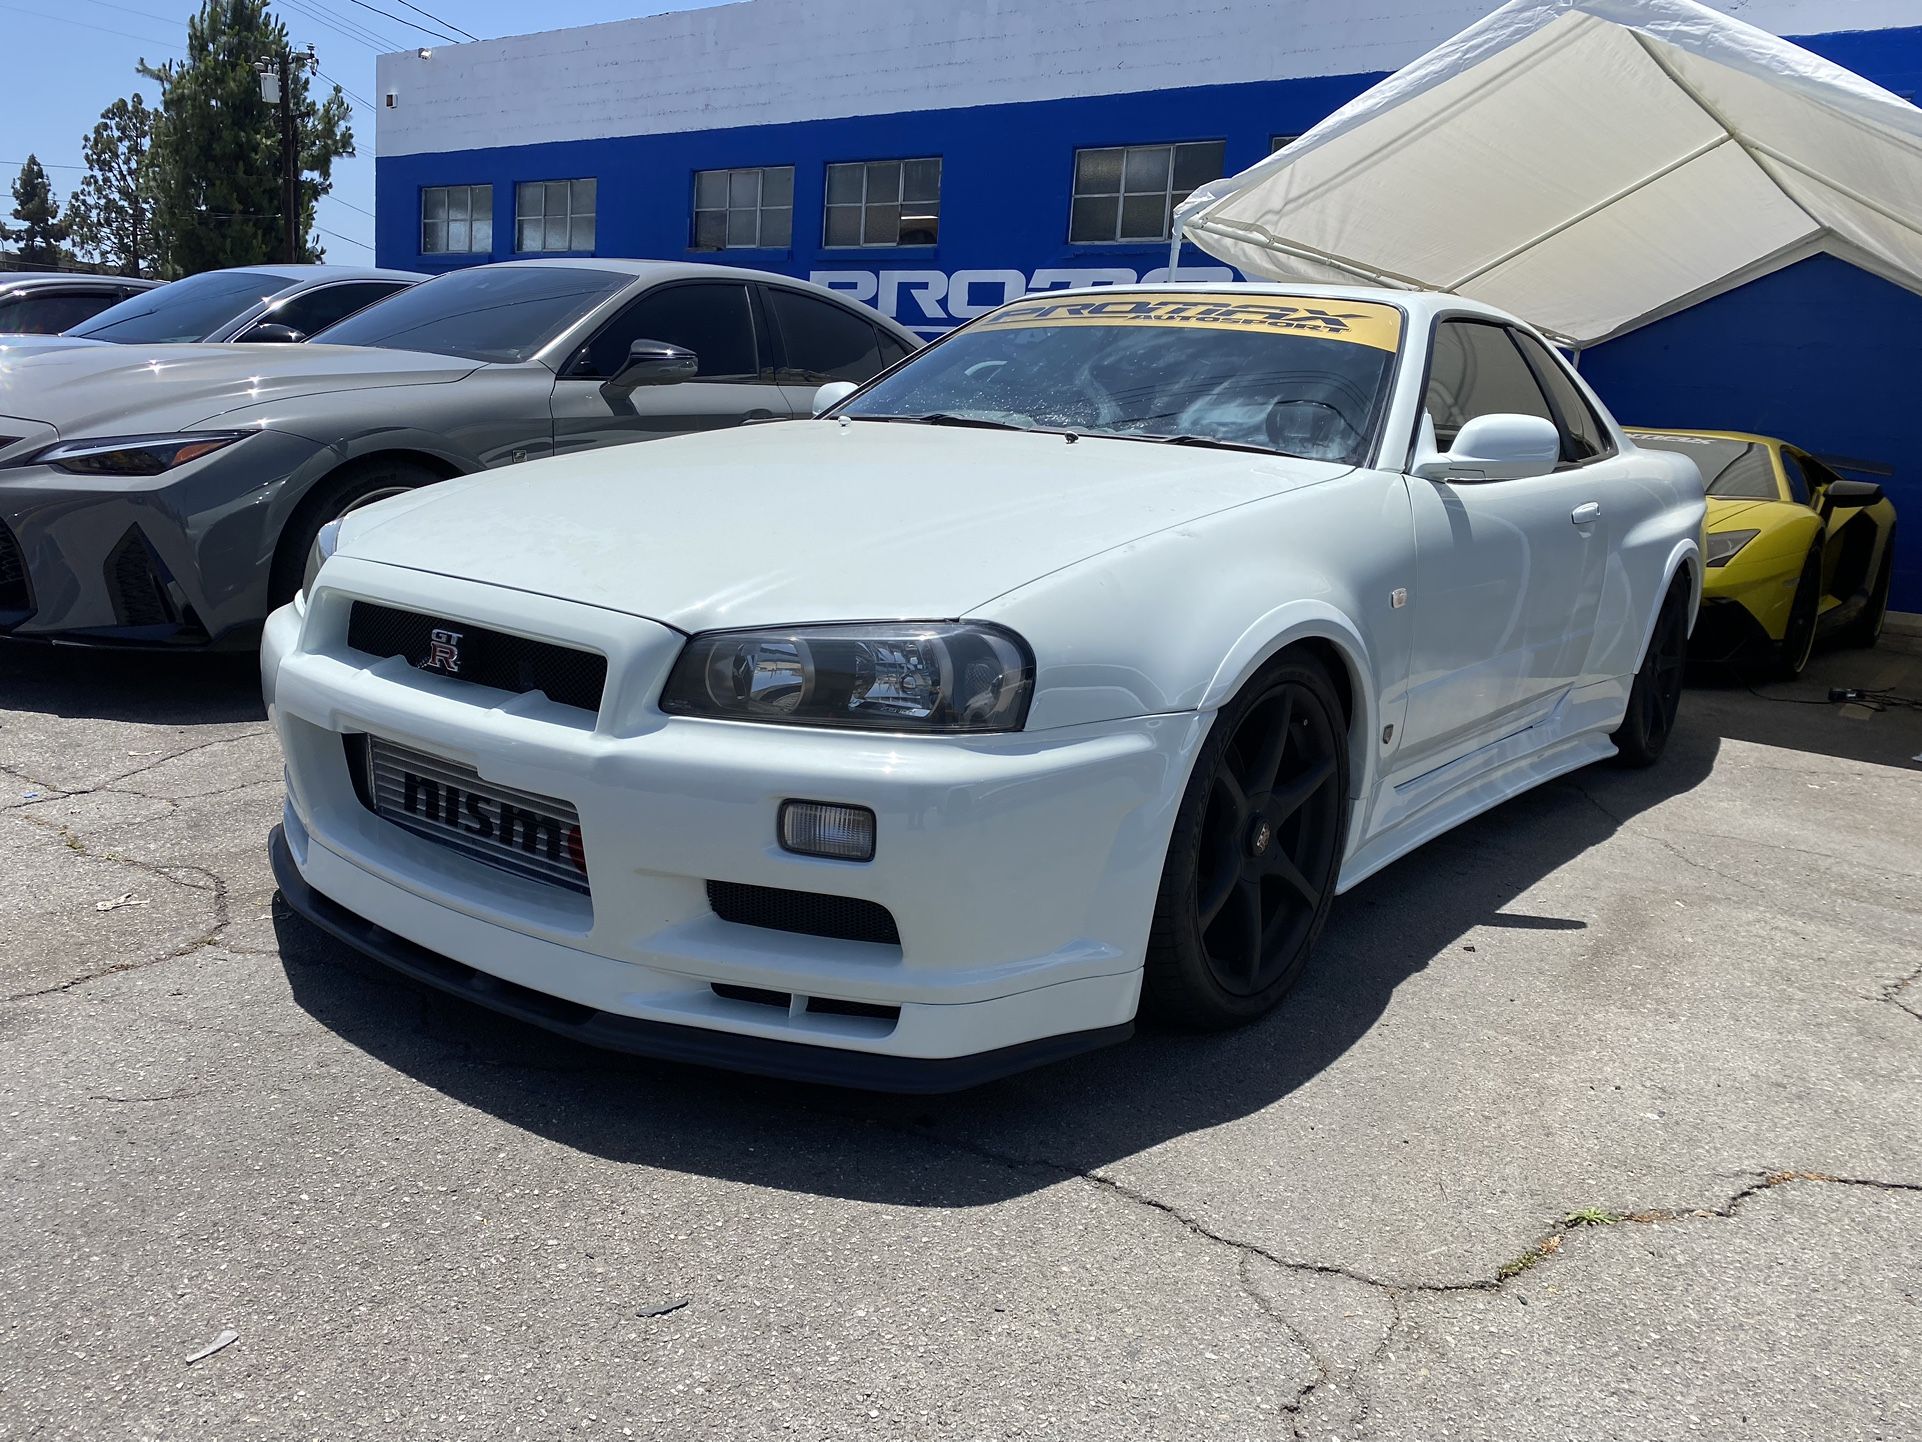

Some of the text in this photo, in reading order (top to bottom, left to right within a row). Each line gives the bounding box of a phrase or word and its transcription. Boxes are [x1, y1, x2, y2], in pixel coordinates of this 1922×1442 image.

[987, 301, 1372, 329] PROMAX
[1127, 314, 1351, 334] AUTOSPORT
[431, 629, 463, 645] GT
[427, 641, 459, 672] R
